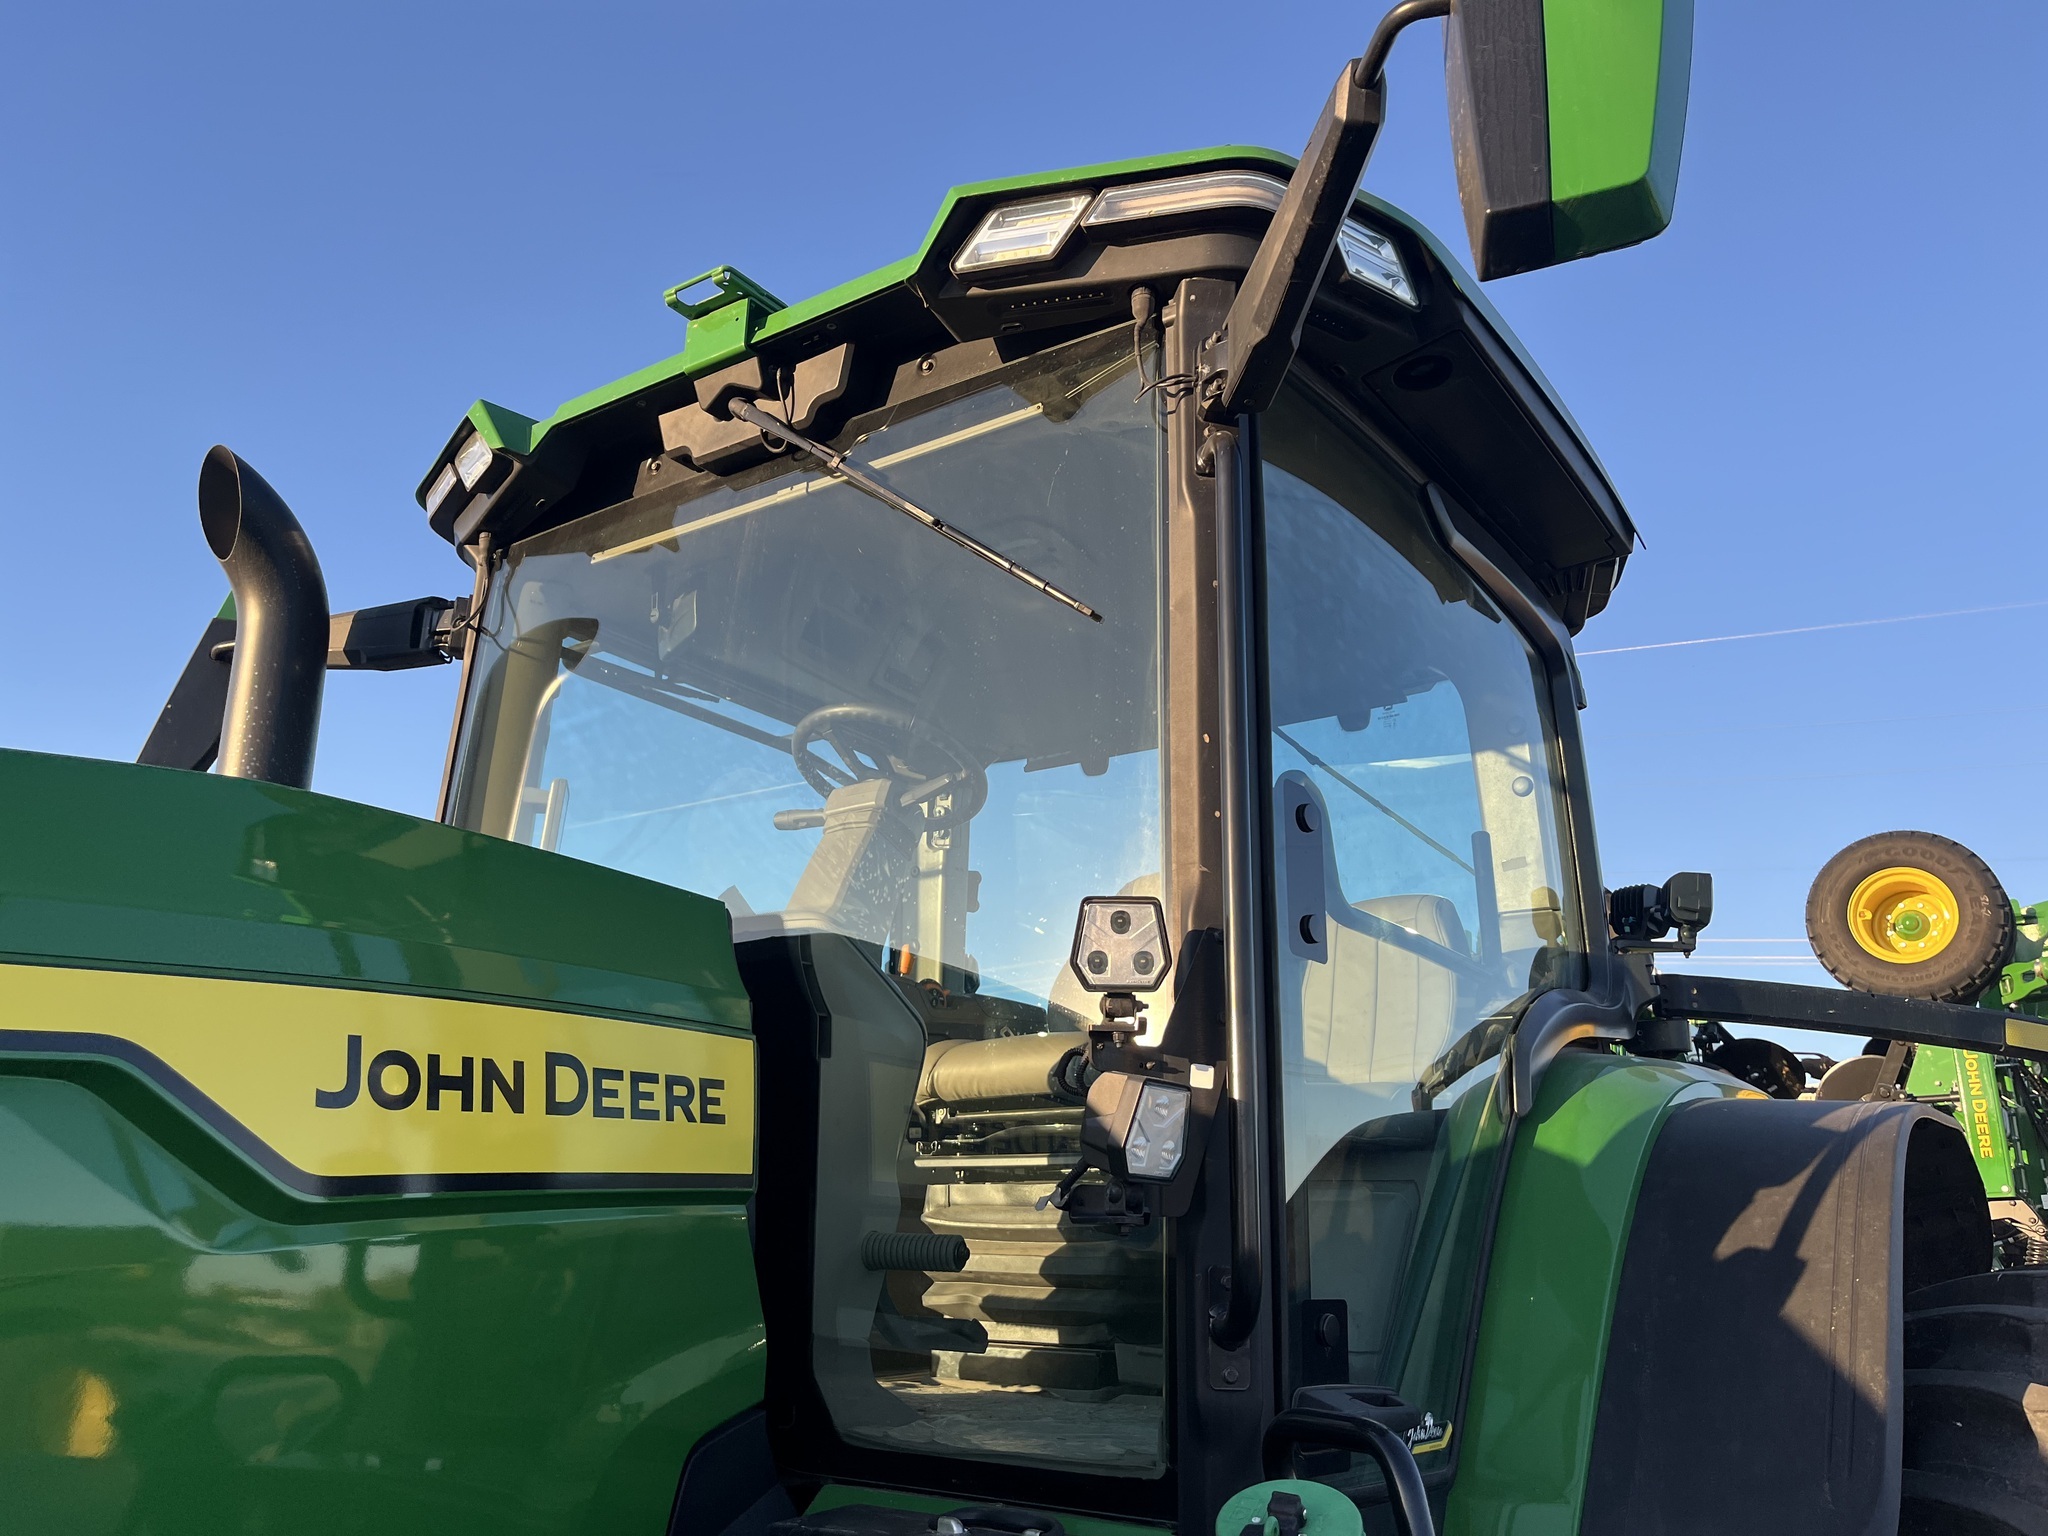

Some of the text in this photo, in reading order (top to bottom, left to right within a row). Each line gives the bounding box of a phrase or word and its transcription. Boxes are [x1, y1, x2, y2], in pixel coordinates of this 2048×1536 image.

[1885, 847, 1985, 944] GOODYEAR
[315, 1034, 727, 1125] JOHN DEERE
[1963, 1049, 1994, 1160] JOHN DEERE
